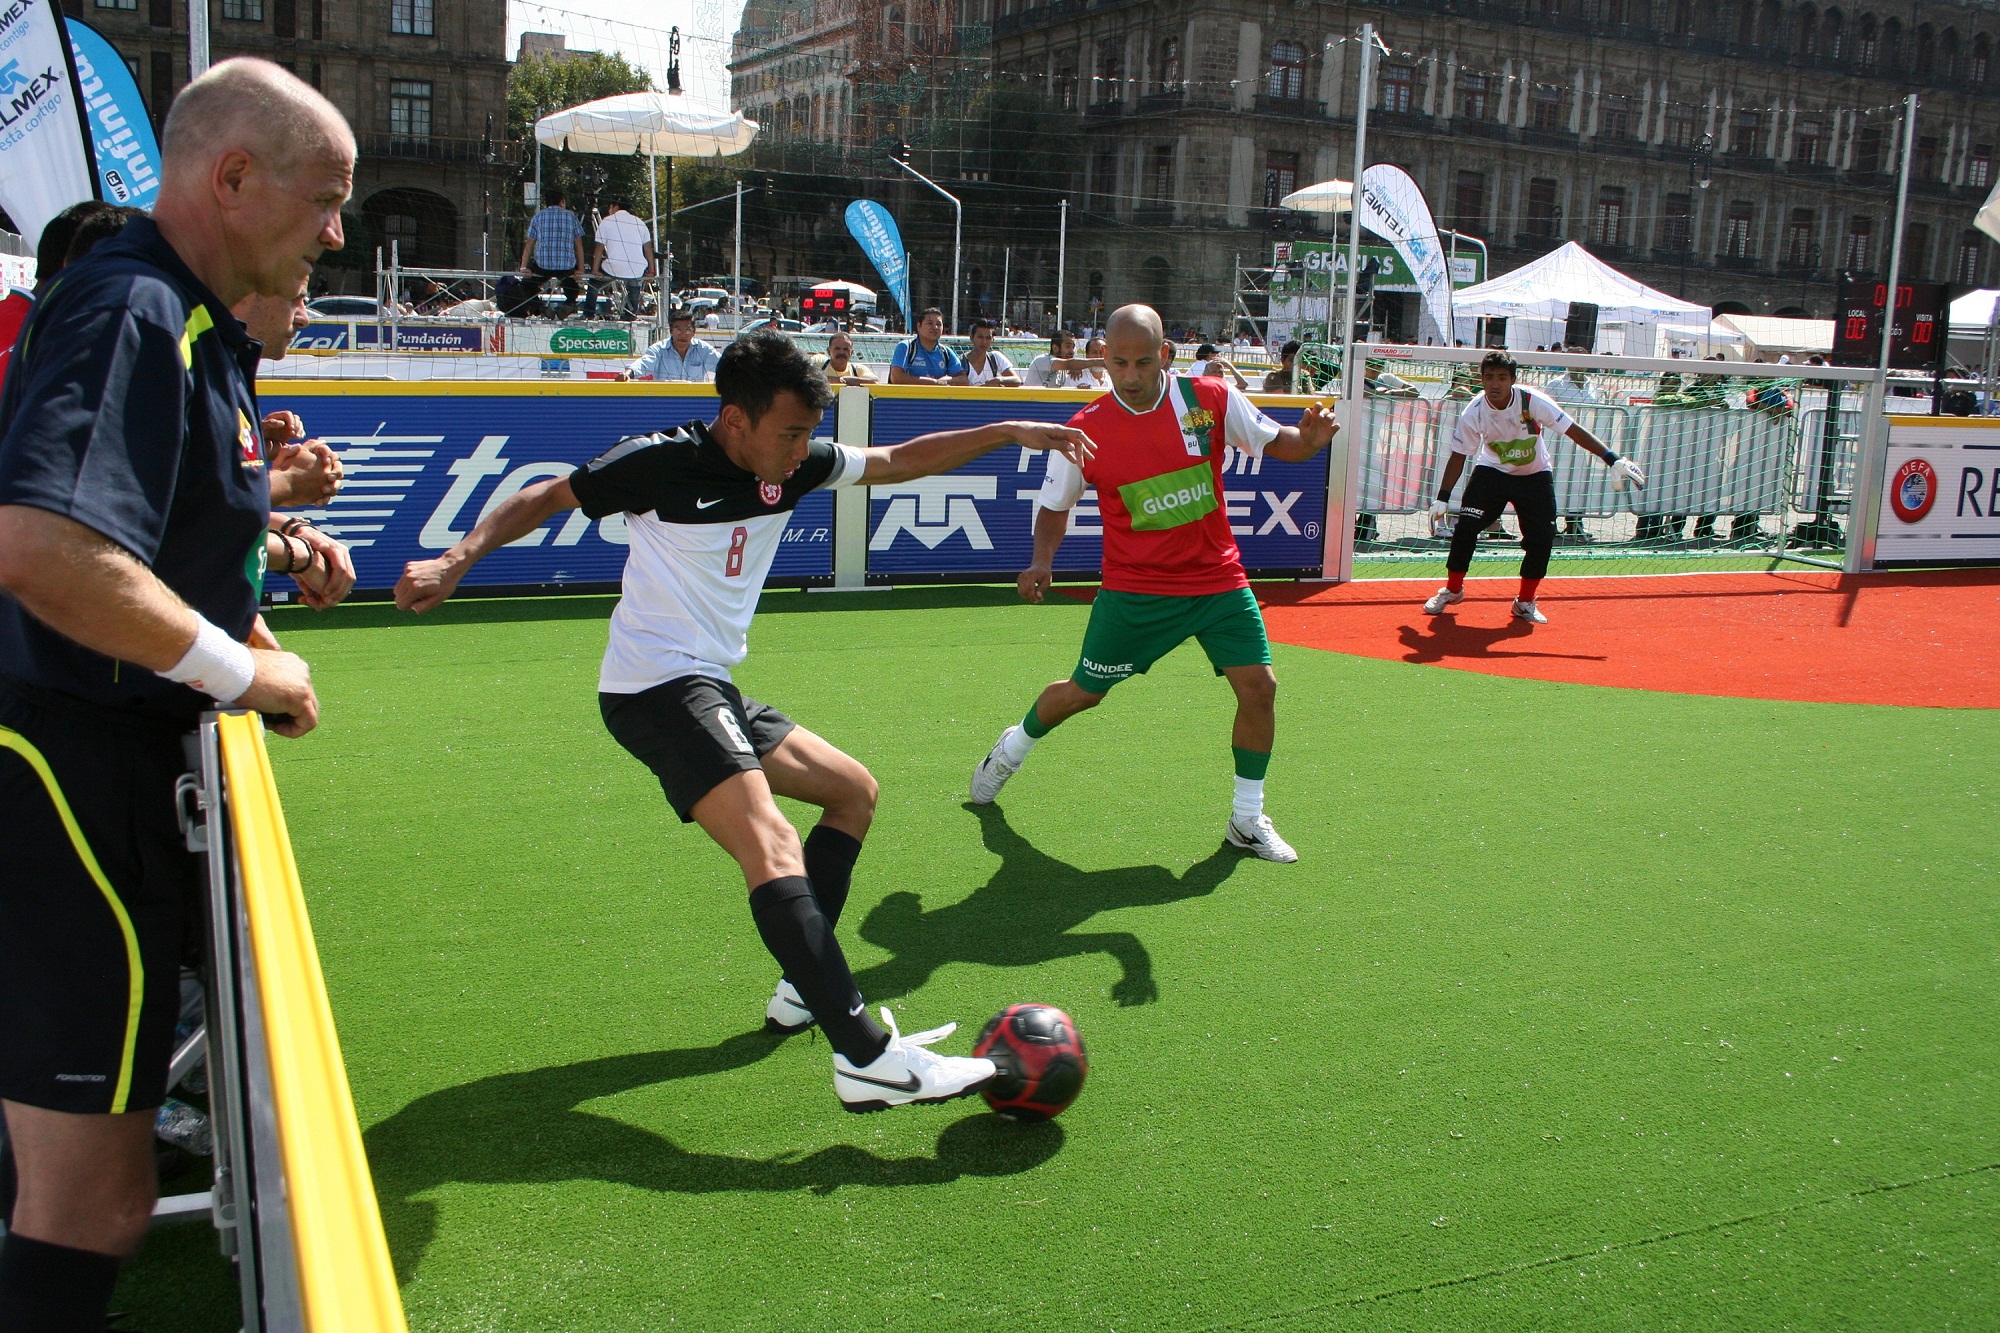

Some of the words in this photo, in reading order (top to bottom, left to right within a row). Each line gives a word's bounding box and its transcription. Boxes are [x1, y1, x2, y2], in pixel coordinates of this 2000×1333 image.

[0, 0, 34, 35] MEX
[0, 66, 60, 132] LMEX
[0, 127, 25, 151] está
[25, 94, 62, 132] contigo
[1361, 184, 1404, 238] TELMEX
[1848, 310, 1866, 318] LOCAL
[1916, 314, 1933, 322] VISITA
[397, 332, 462, 345] Fundación
[1912, 322, 1933, 343] 00
[557, 336, 629, 351] Specsavers
[1901, 462, 1931, 477] UEFA
[1142, 482, 1211, 515] GLOBUL
[781, 529, 804, 543] M.
[809, 528, 829, 542] R.
[725, 526, 748, 577] 8
[1082, 657, 1133, 673] DUNDEE
